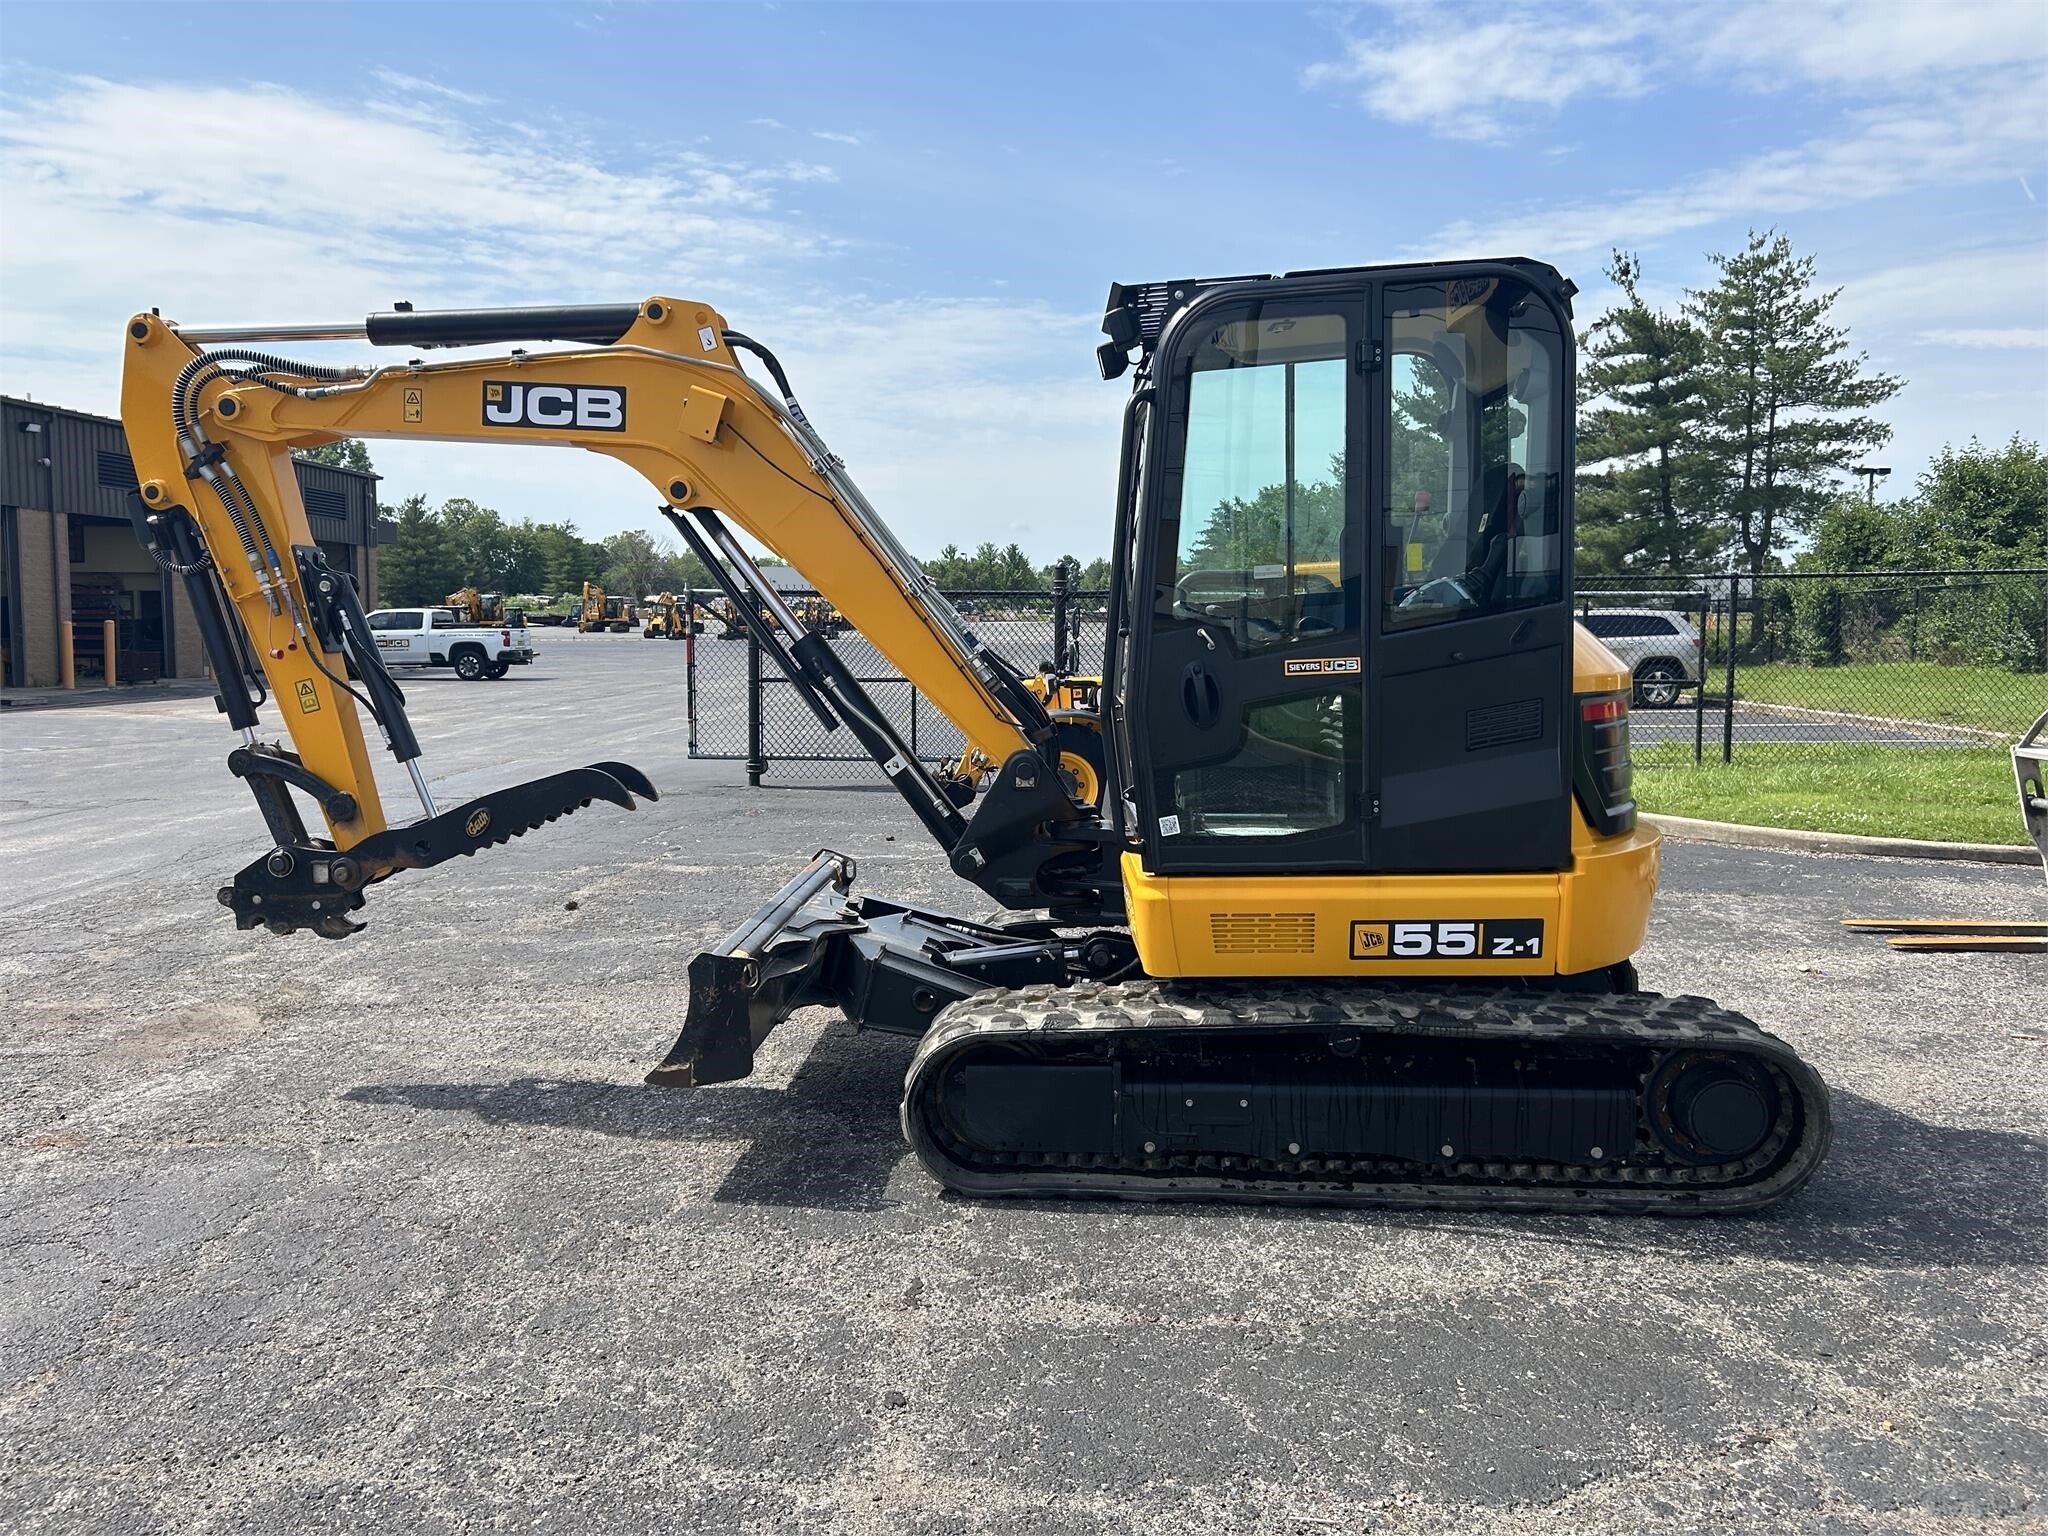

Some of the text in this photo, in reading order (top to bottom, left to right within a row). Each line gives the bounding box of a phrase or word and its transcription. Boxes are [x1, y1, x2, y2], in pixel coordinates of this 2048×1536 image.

[487, 385, 623, 428] JCB
[1289, 660, 1358, 671] SIEVERS JCB
[1362, 932, 1383, 948] JCB
[1393, 923, 1540, 956] 55 Z-1
